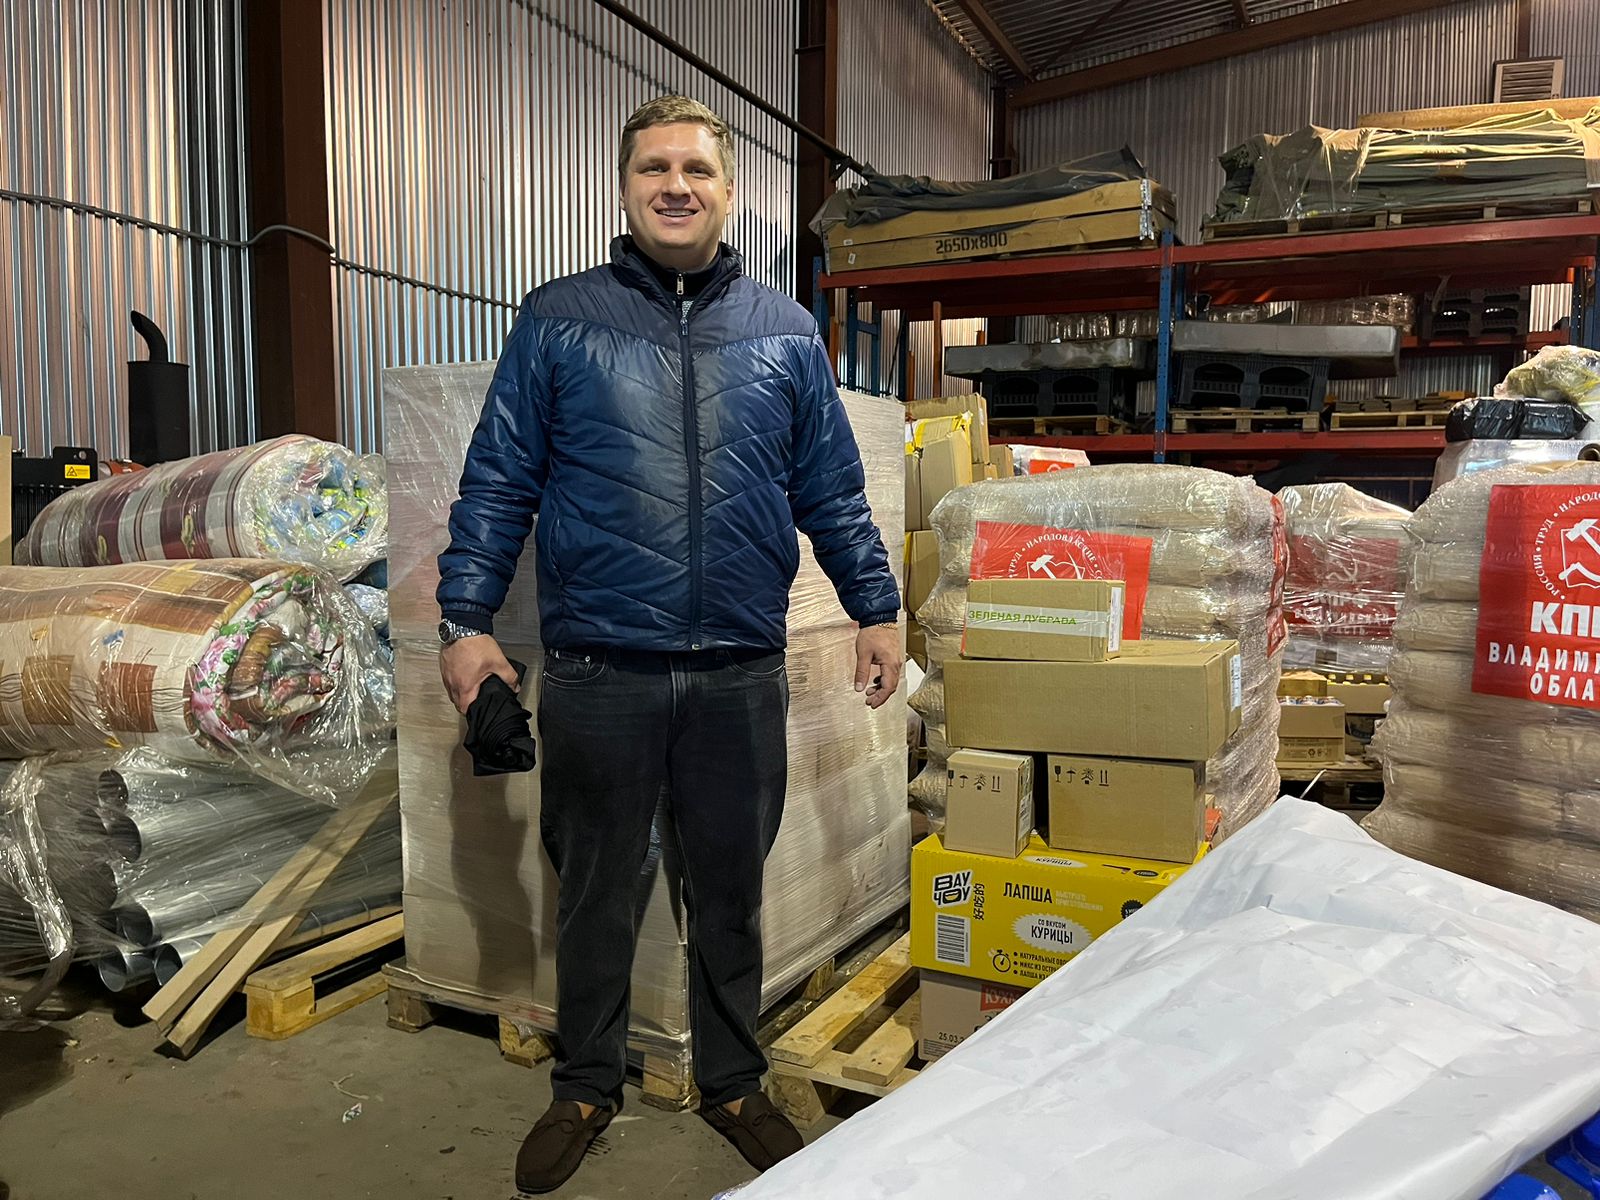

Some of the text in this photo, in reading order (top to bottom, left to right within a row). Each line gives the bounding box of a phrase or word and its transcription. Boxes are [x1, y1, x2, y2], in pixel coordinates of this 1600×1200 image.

[1559, 491, 1600, 512] НАРОД
[1535, 519, 1554, 545] ТРУД
[1026, 533, 1096, 563] НАРОДОВЛАСТИЕ
[1009, 552, 1022, 574] ТРУД
[1533, 554, 1560, 596] РОССИЯ
[969, 610, 1021, 622] ЗЕЛЕНАЯ
[1003, 882, 1053, 904] ЛАПША
[1031, 925, 1073, 944] КУРИЦЫ
[1046, 919, 1067, 929] ВКУСОМ
